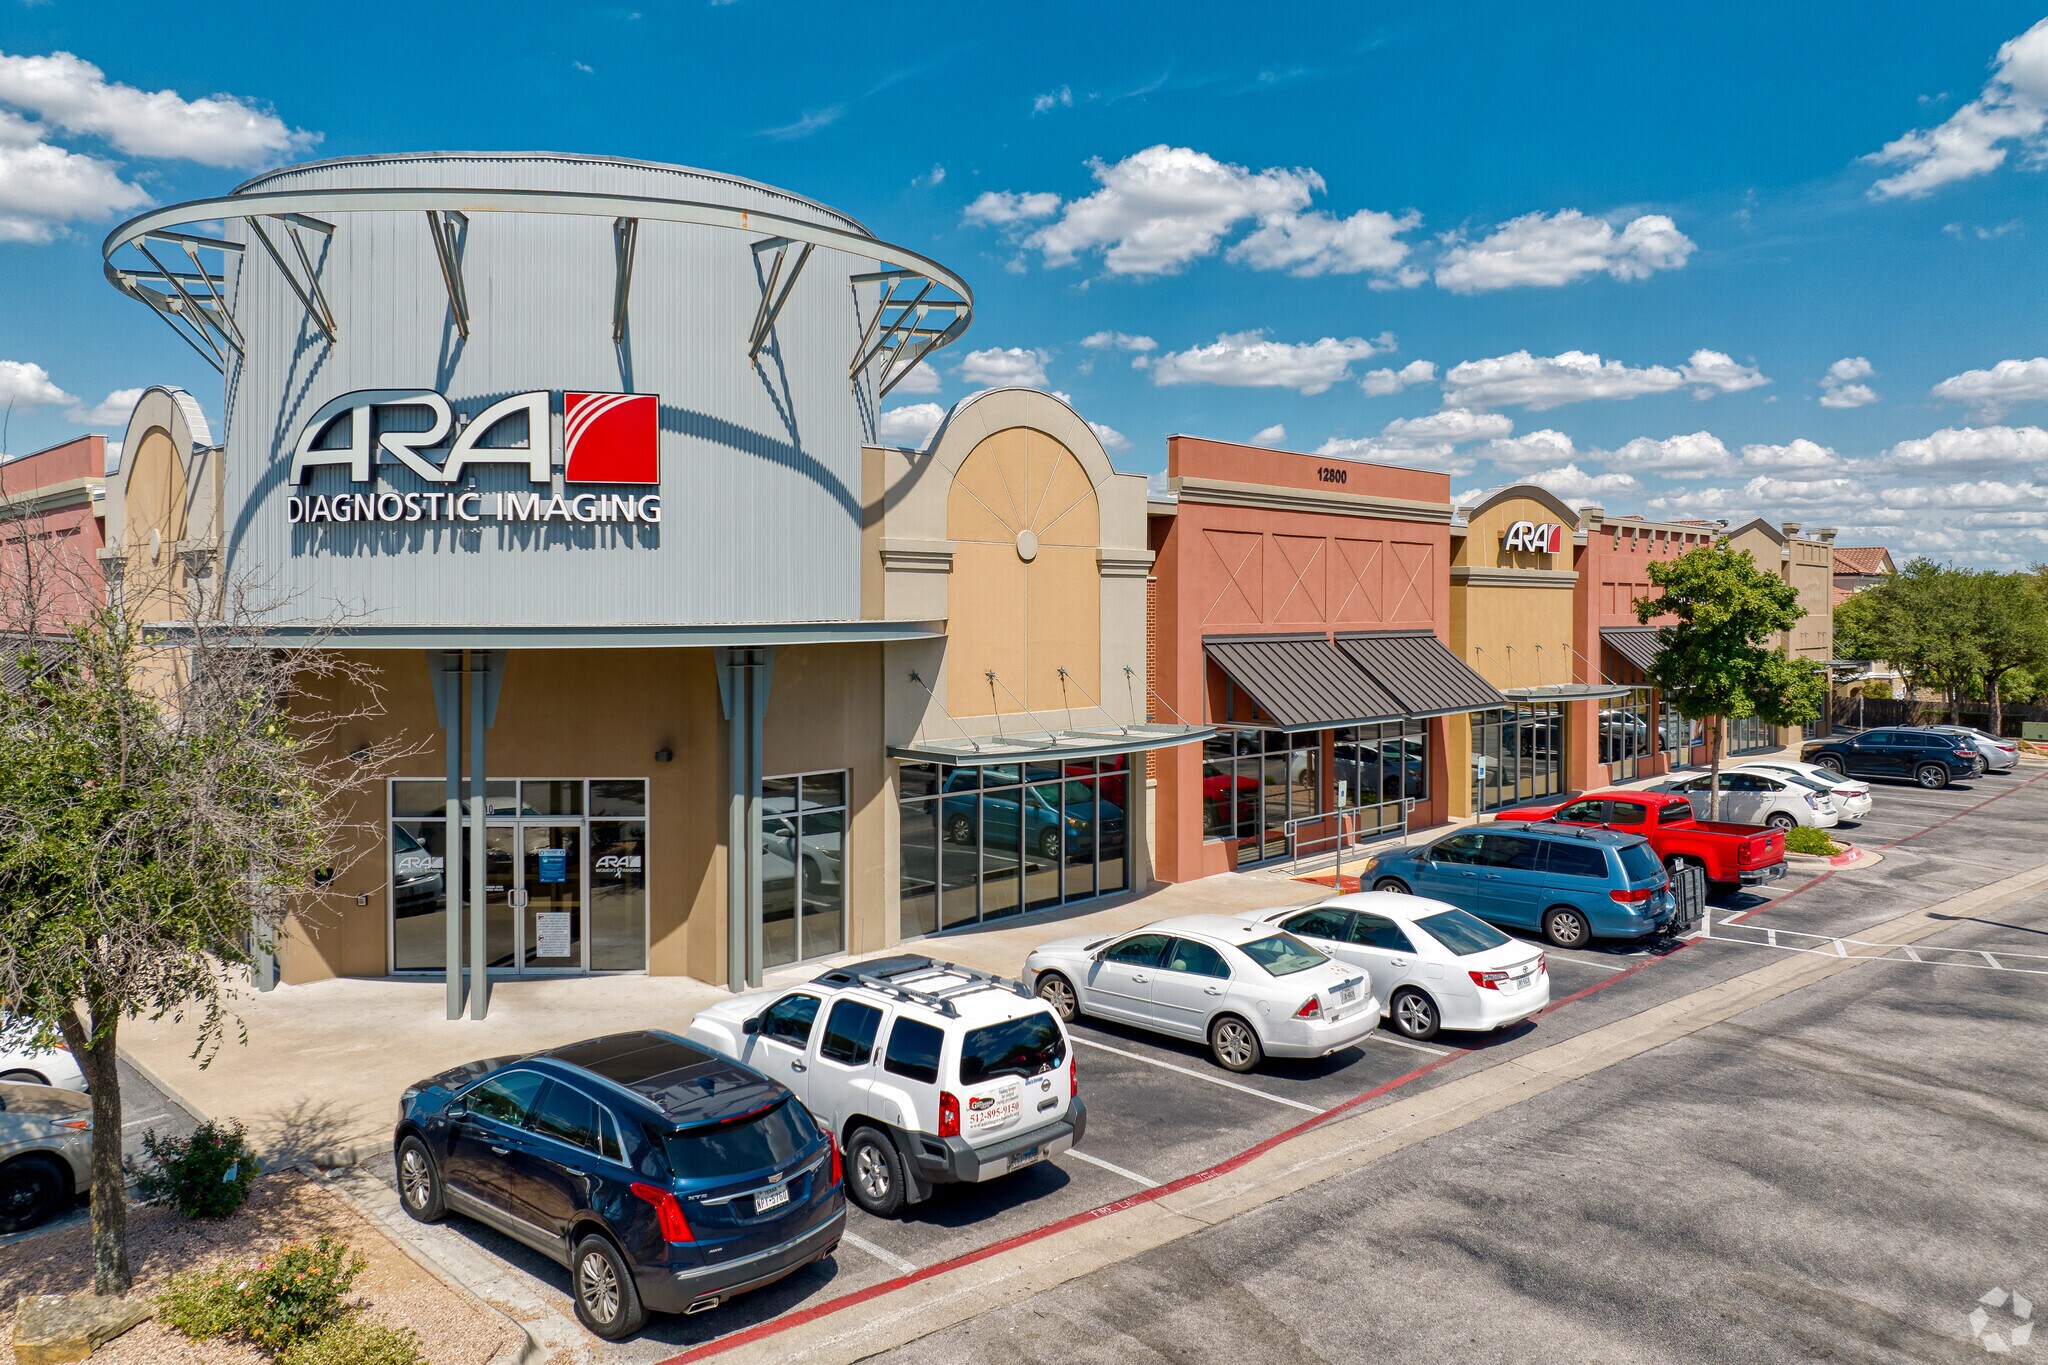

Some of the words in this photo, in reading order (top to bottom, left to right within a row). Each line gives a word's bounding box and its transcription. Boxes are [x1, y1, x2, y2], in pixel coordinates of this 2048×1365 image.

[288, 387, 552, 486] ARA
[1317, 466, 1347, 484] 12800
[287, 492, 481, 524] DIAGNOSTIC
[496, 493, 662, 524] IMAGING
[1502, 520, 1549, 554] ARA
[398, 856, 432, 869] ARA
[595, 855, 630, 868] ARA
[969, 1101, 1020, 1124] 512-895-9150
[764, 1187, 778, 1195] TEXAS
